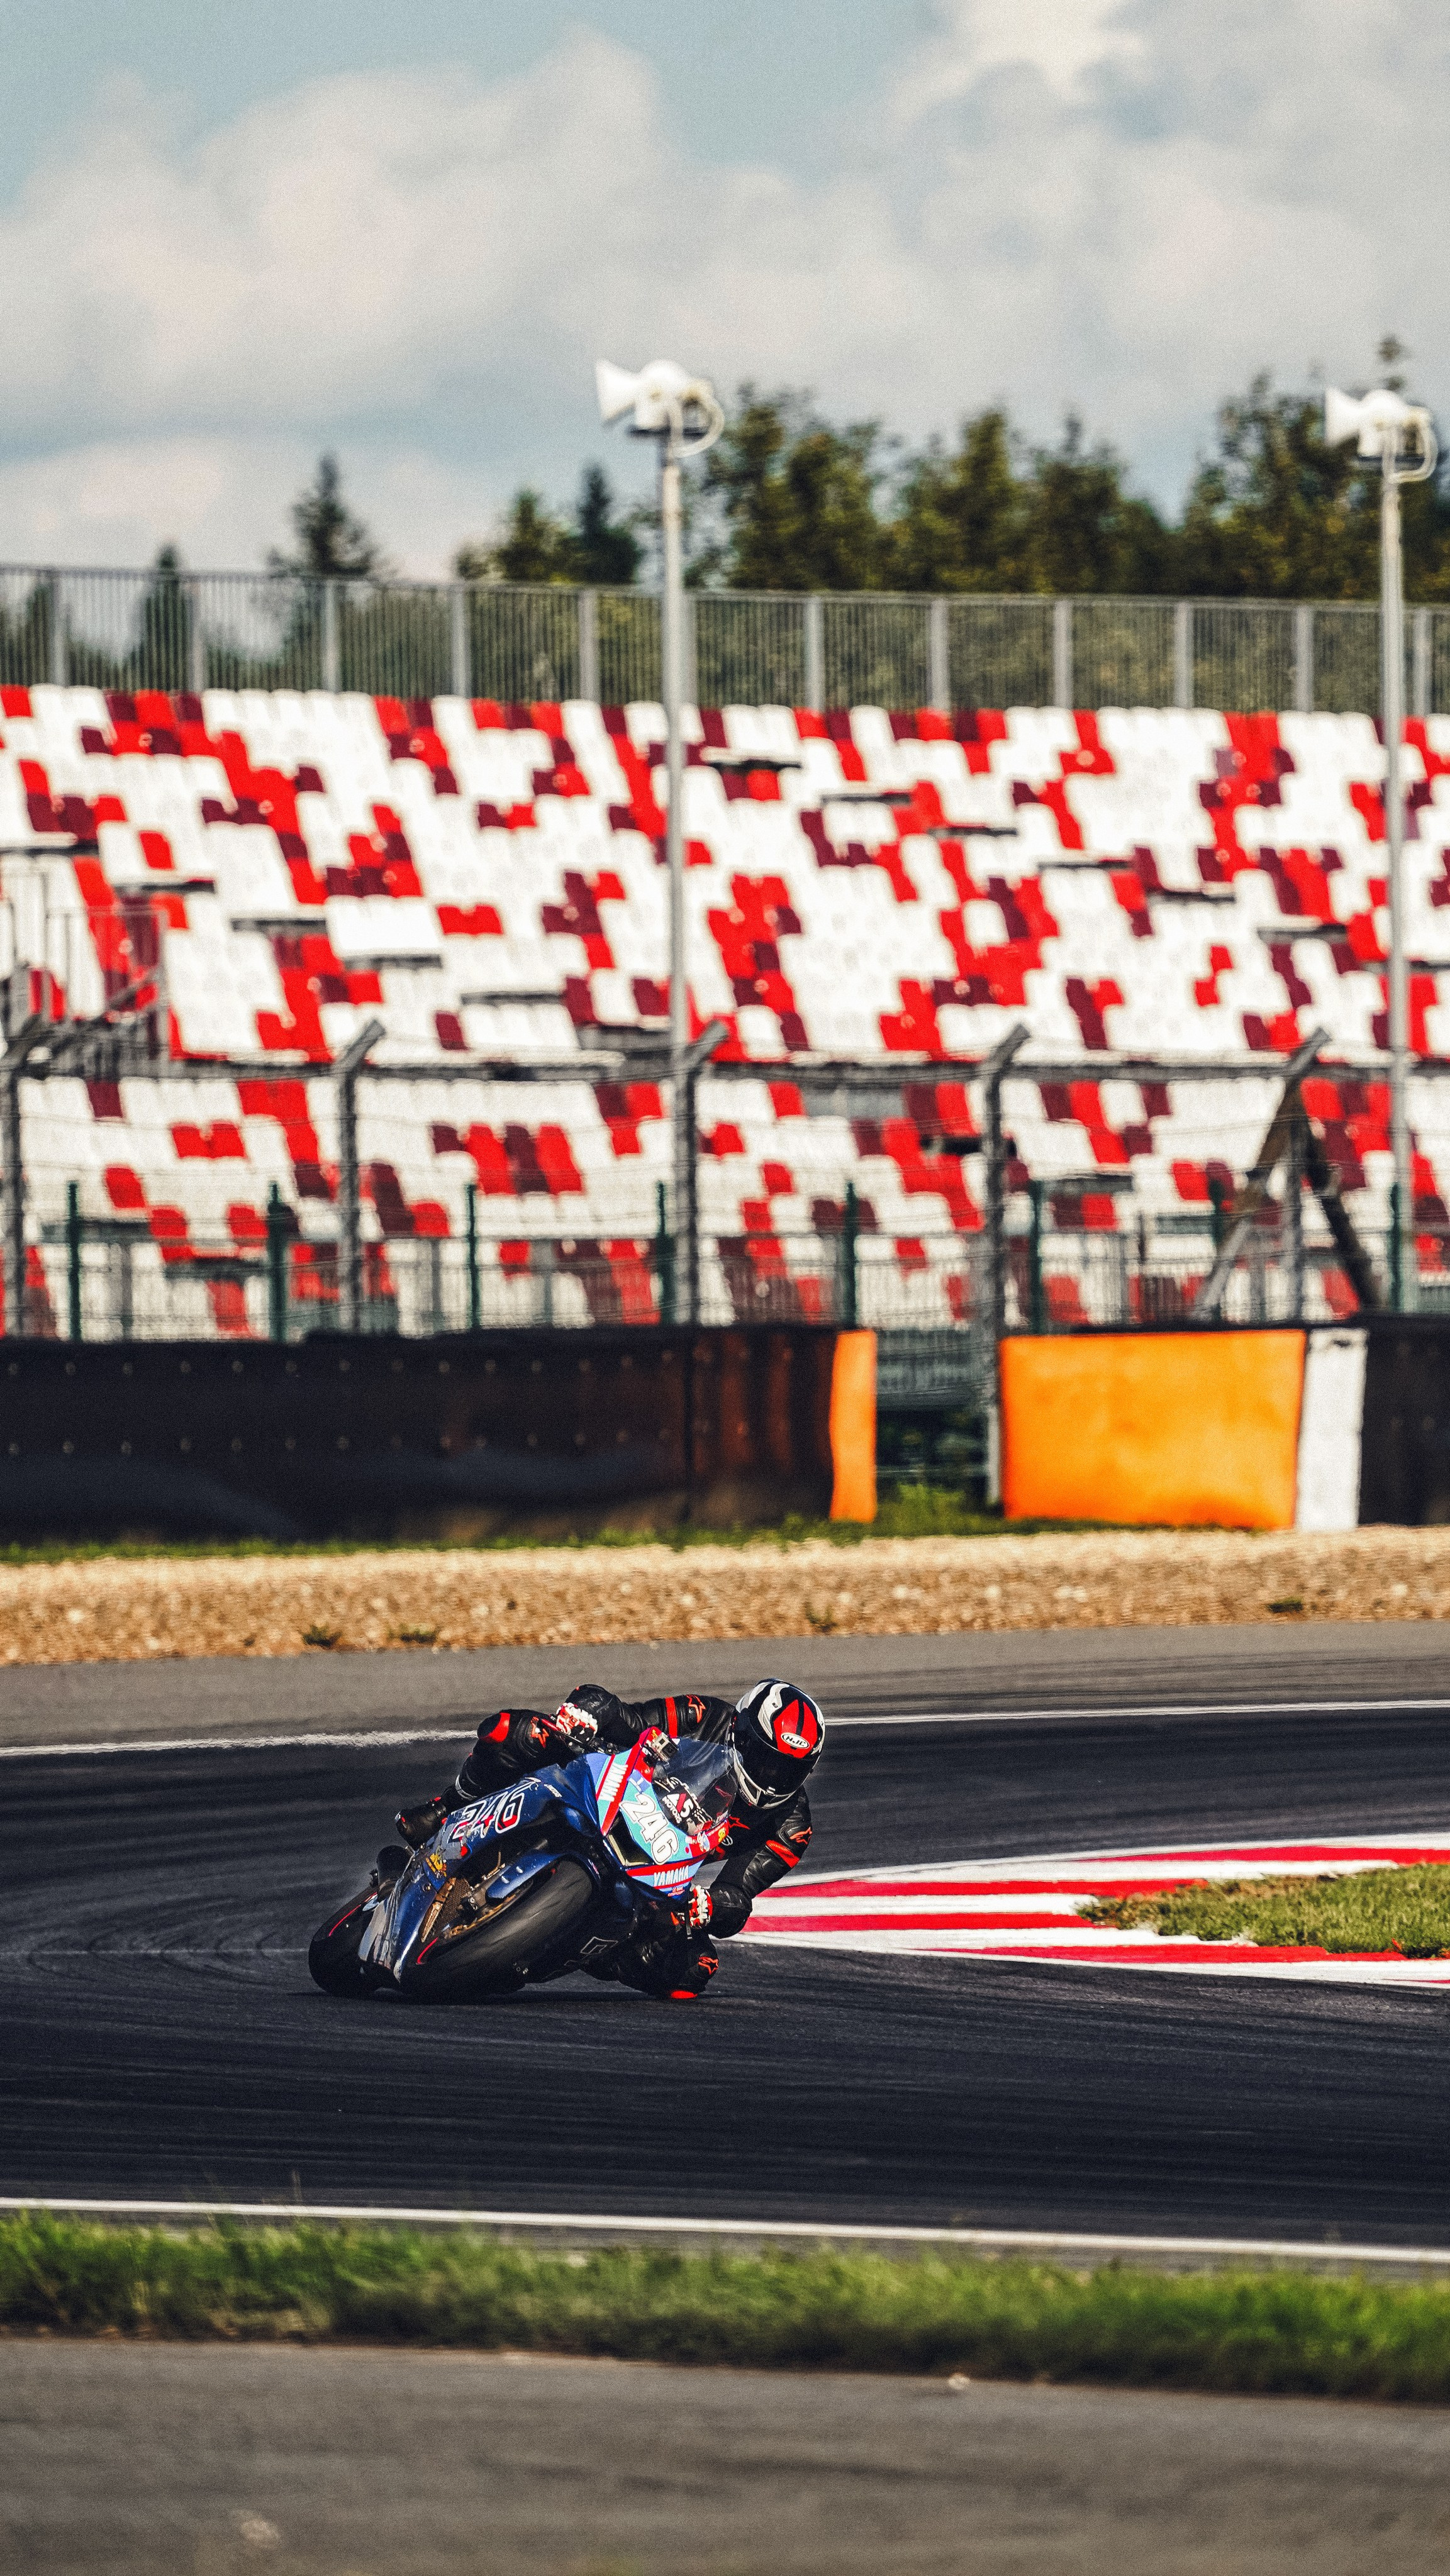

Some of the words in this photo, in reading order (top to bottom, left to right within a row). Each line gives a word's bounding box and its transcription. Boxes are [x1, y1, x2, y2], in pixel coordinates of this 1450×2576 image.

[786, 1736, 806, 1746] HJC
[600, 1763, 628, 1802] YAMAHA
[447, 1781, 536, 1843] 246
[662, 1796, 682, 1824] MOTORS
[620, 1794, 678, 1865] 246
[654, 1865, 689, 1887] YAMAHA
